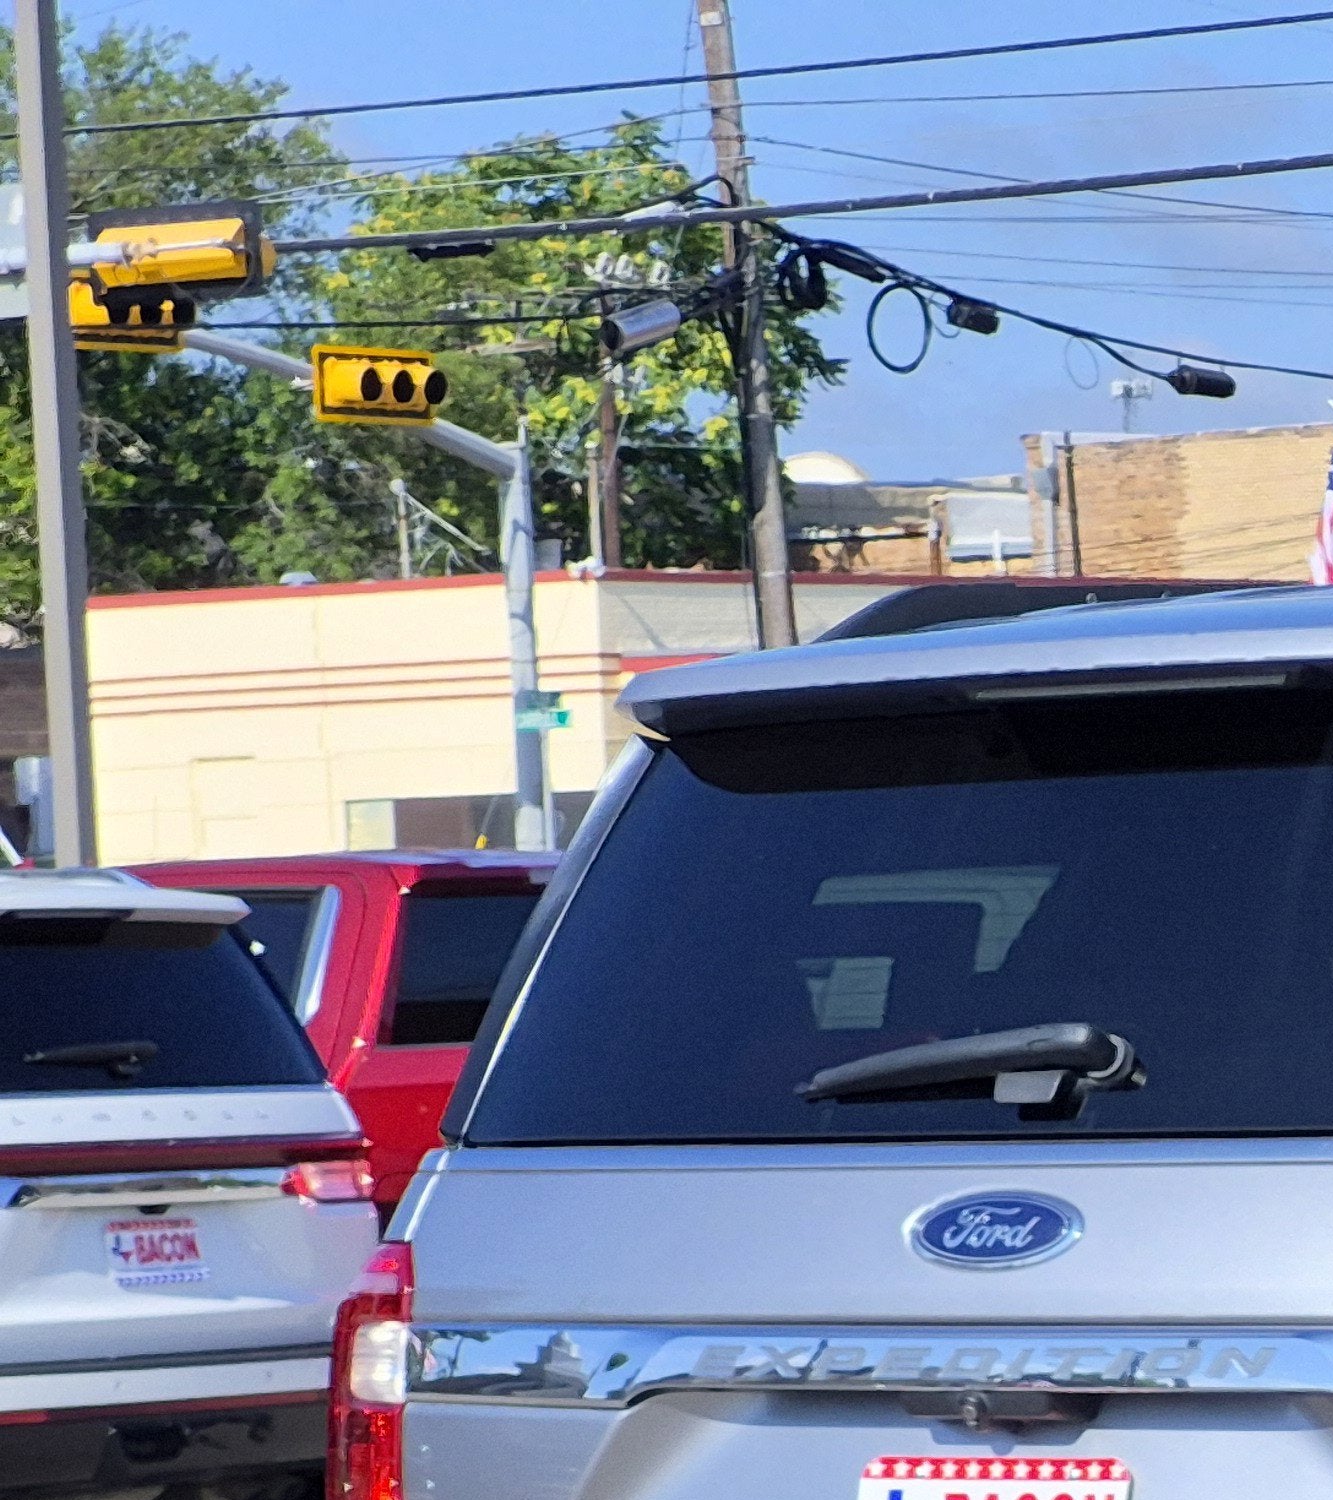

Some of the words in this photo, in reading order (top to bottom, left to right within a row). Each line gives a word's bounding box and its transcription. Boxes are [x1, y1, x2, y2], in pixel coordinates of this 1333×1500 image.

[942, 1205, 1042, 1249] Ford
[135, 1232, 202, 1266] BACON
[693, 1344, 1279, 1381] EXPEDITION
